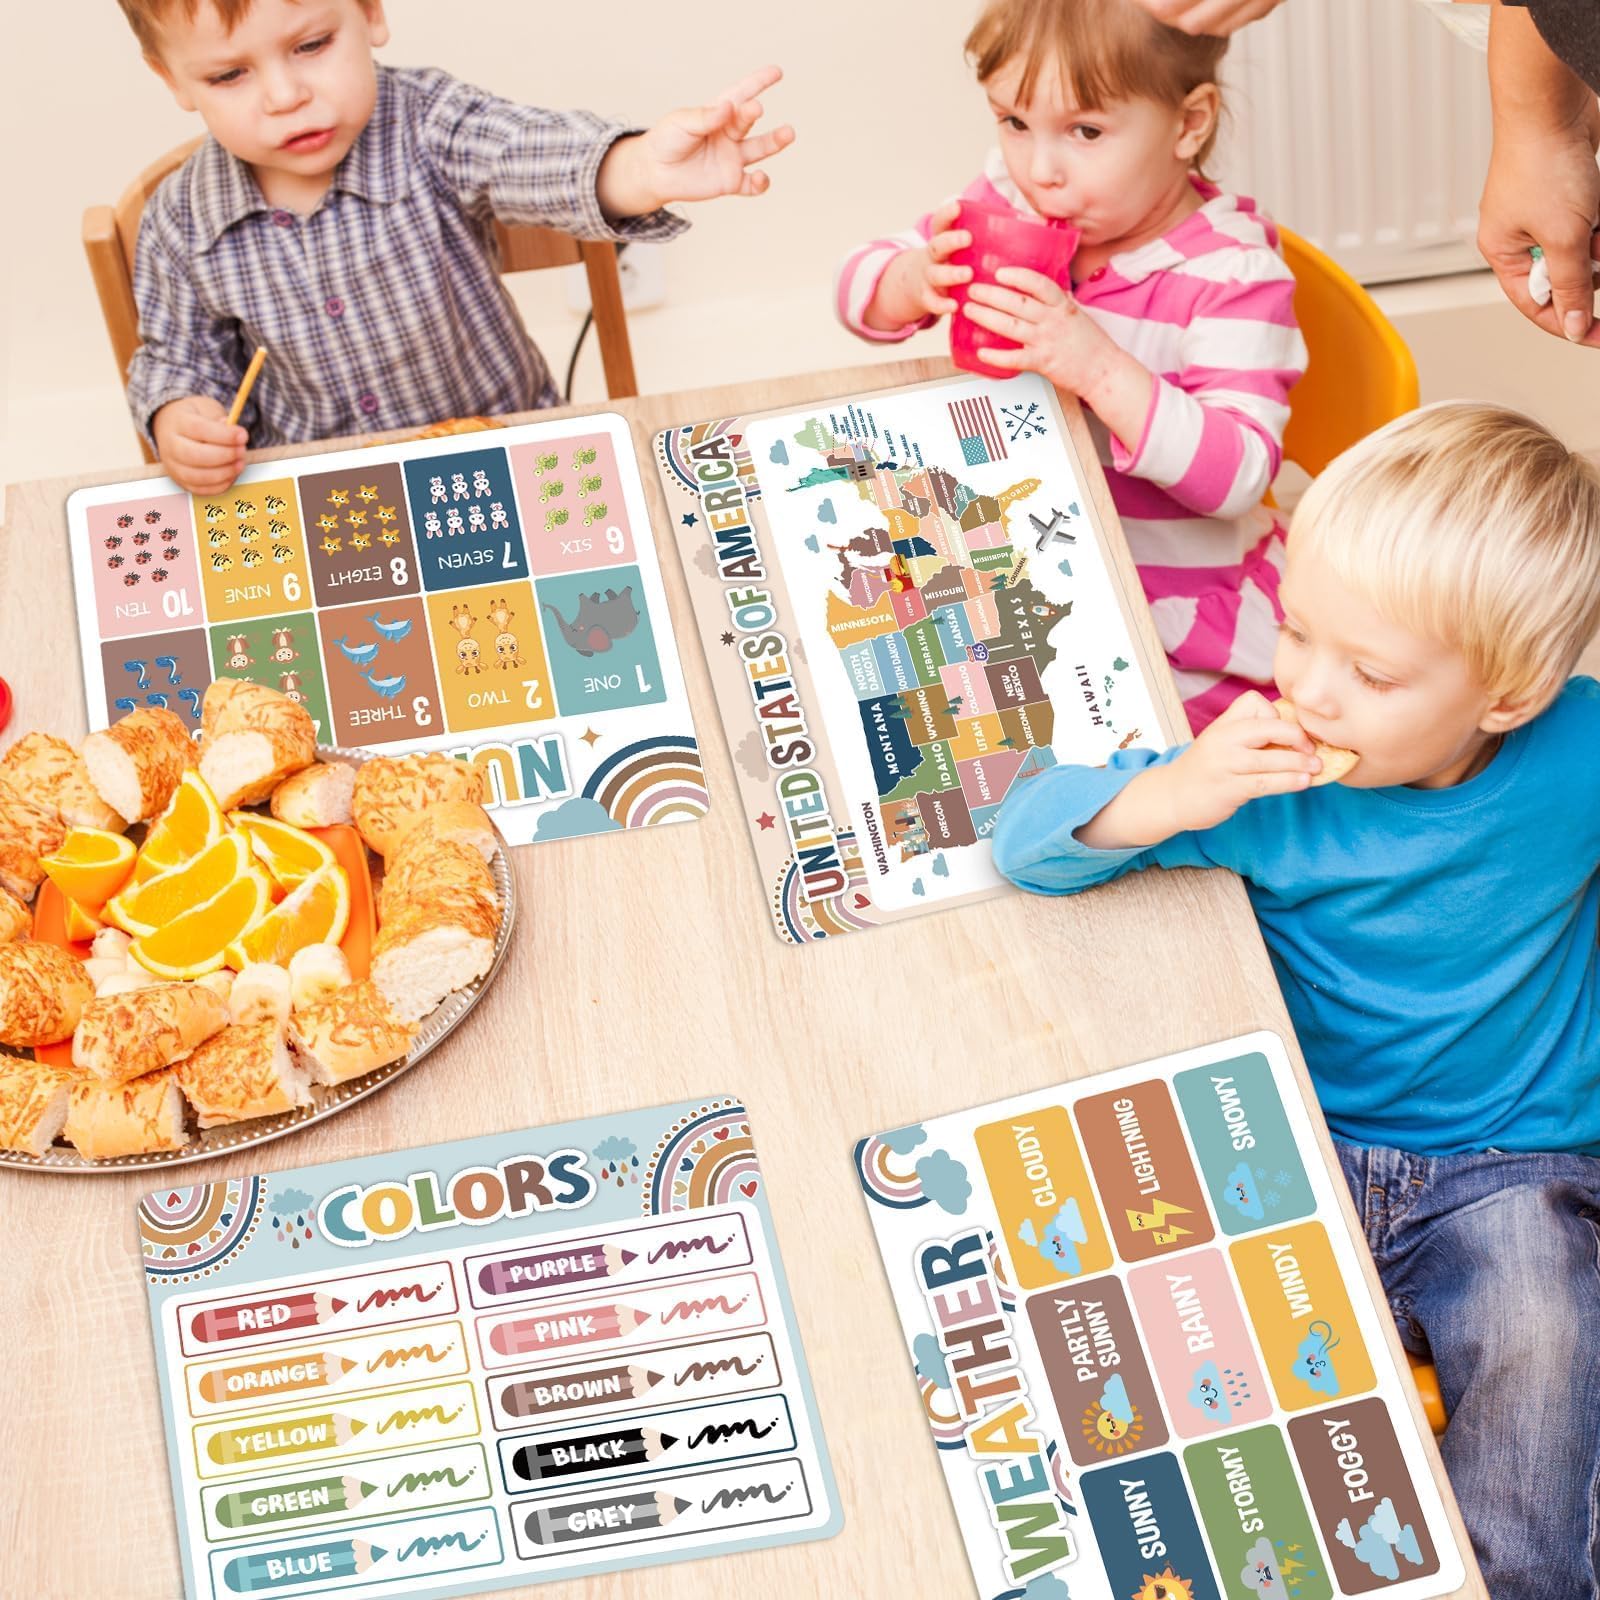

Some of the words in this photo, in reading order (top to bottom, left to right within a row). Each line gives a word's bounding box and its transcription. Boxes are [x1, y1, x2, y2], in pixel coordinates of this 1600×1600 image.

[1005, 420, 1014, 428] N
[1024, 431, 1032, 439] W
[1001, 482, 1034, 502] FLORIDA
[691, 438, 762, 578] AMERICA
[975, 502, 986, 523] GEORGIA
[604, 526, 625, 554] 6
[894, 515, 905, 534] OHIO
[438, 549, 494, 570] SEVEN
[501, 541, 518, 570] 7
[560, 538, 592, 554] SIX
[282, 572, 302, 601] 9
[327, 566, 383, 587] EIGHT
[389, 556, 410, 586] 8
[162, 588, 194, 618] 10
[224, 583, 271, 604] NINE
[904, 596, 915, 617] IOWA
[924, 585, 965, 601] MISSOURI
[115, 602, 151, 618] TEN
[729, 589, 773, 629] OF
[830, 613, 894, 634] MINNESOTA
[1010, 597, 1036, 651] TEXAS
[945, 608, 965, 648] KANSAS
[884, 633, 901, 665] DAKOTA
[916, 628, 937, 678] NEBRASKA
[973, 644, 986, 659] 66
[584, 674, 622, 694] ONE
[635, 664, 652, 693] 1
[850, 654, 868, 691] NORTH
[860, 647, 879, 692] DAKOTA
[894, 665, 909, 690] SOUTH
[1008, 664, 1027, 701] MEXICO
[468, 689, 511, 708] TWO
[521, 679, 543, 709] 2
[743, 637, 811, 765] STATES
[959, 665, 980, 715] COLORADO
[1001, 675, 1016, 698] NEW
[1075, 665, 1104, 726] HAWAII
[349, 705, 407, 727] THREE
[412, 696, 432, 726] 3
[916, 689, 938, 740] WYOMING
[1017, 705, 1036, 745] ARIZONA
[870, 702, 900, 775] MONTANA
[971, 721, 988, 752] UTAH
[931, 743, 953, 787] IDAHO
[972, 759, 992, 801] NEVADA
[780, 772, 845, 898] UNITED
[932, 800, 950, 839] OREGON
[861, 801, 890, 876] WASHINGTON
[1210, 1076, 1256, 1151] SNOWY
[1112, 1097, 1161, 1195] LIGHTNING
[1011, 1124, 1057, 1208] CLOUDY
[323, 1154, 590, 1241] COLORS
[509, 1253, 598, 1284] PURPLE
[1267, 1242, 1313, 1320] WINDY
[236, 1303, 292, 1332] RED
[533, 1314, 598, 1343] PINK
[1165, 1273, 1215, 1354] RAINY
[1054, 1298, 1099, 1383] PARTLY
[1081, 1300, 1122, 1369] SUNNY
[226, 1361, 320, 1393] ORANGE
[533, 1375, 622, 1407] BROWN
[921, 1233, 1070, 1580] WEATHER
[235, 1423, 327, 1455] YELLOW
[551, 1438, 627, 1468] BLACK
[1322, 1418, 1375, 1504] FOGGY
[250, 1486, 330, 1517] GREEN
[1216, 1446, 1265, 1535] STORMY
[567, 1503, 636, 1534] GREY
[1119, 1479, 1167, 1561] SUNNY
[266, 1552, 333, 1581] BLUE
